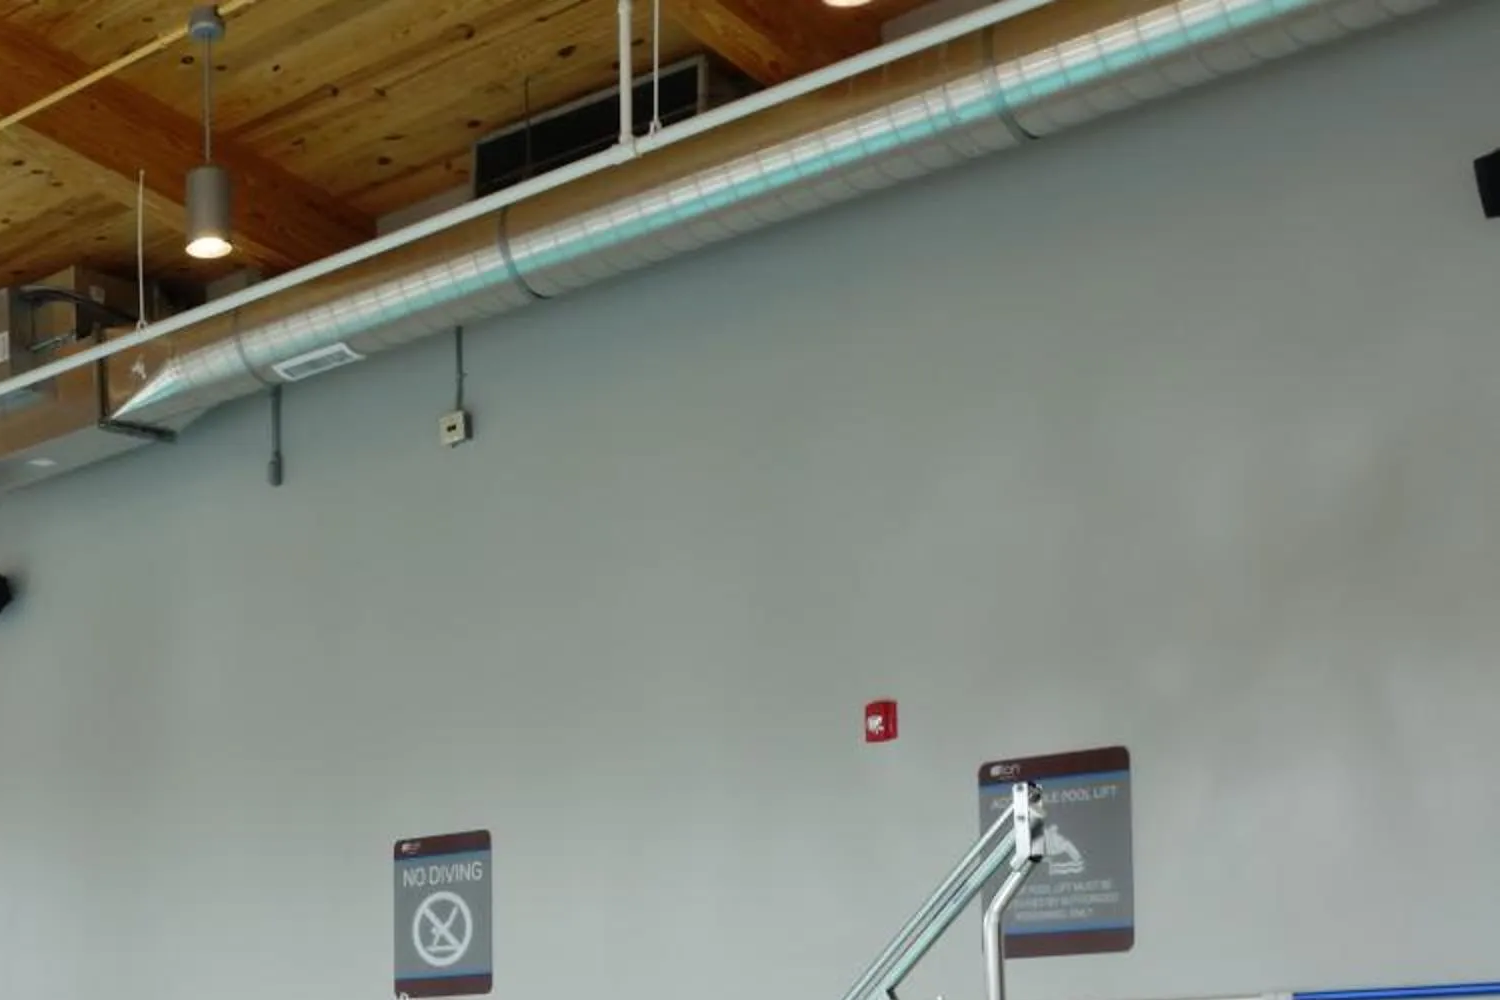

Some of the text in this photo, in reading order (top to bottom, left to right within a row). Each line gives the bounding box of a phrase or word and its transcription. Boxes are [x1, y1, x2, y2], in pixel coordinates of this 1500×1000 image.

[1092, 785, 1118, 800] LIFT
[403, 860, 483, 888] NO DIVING
